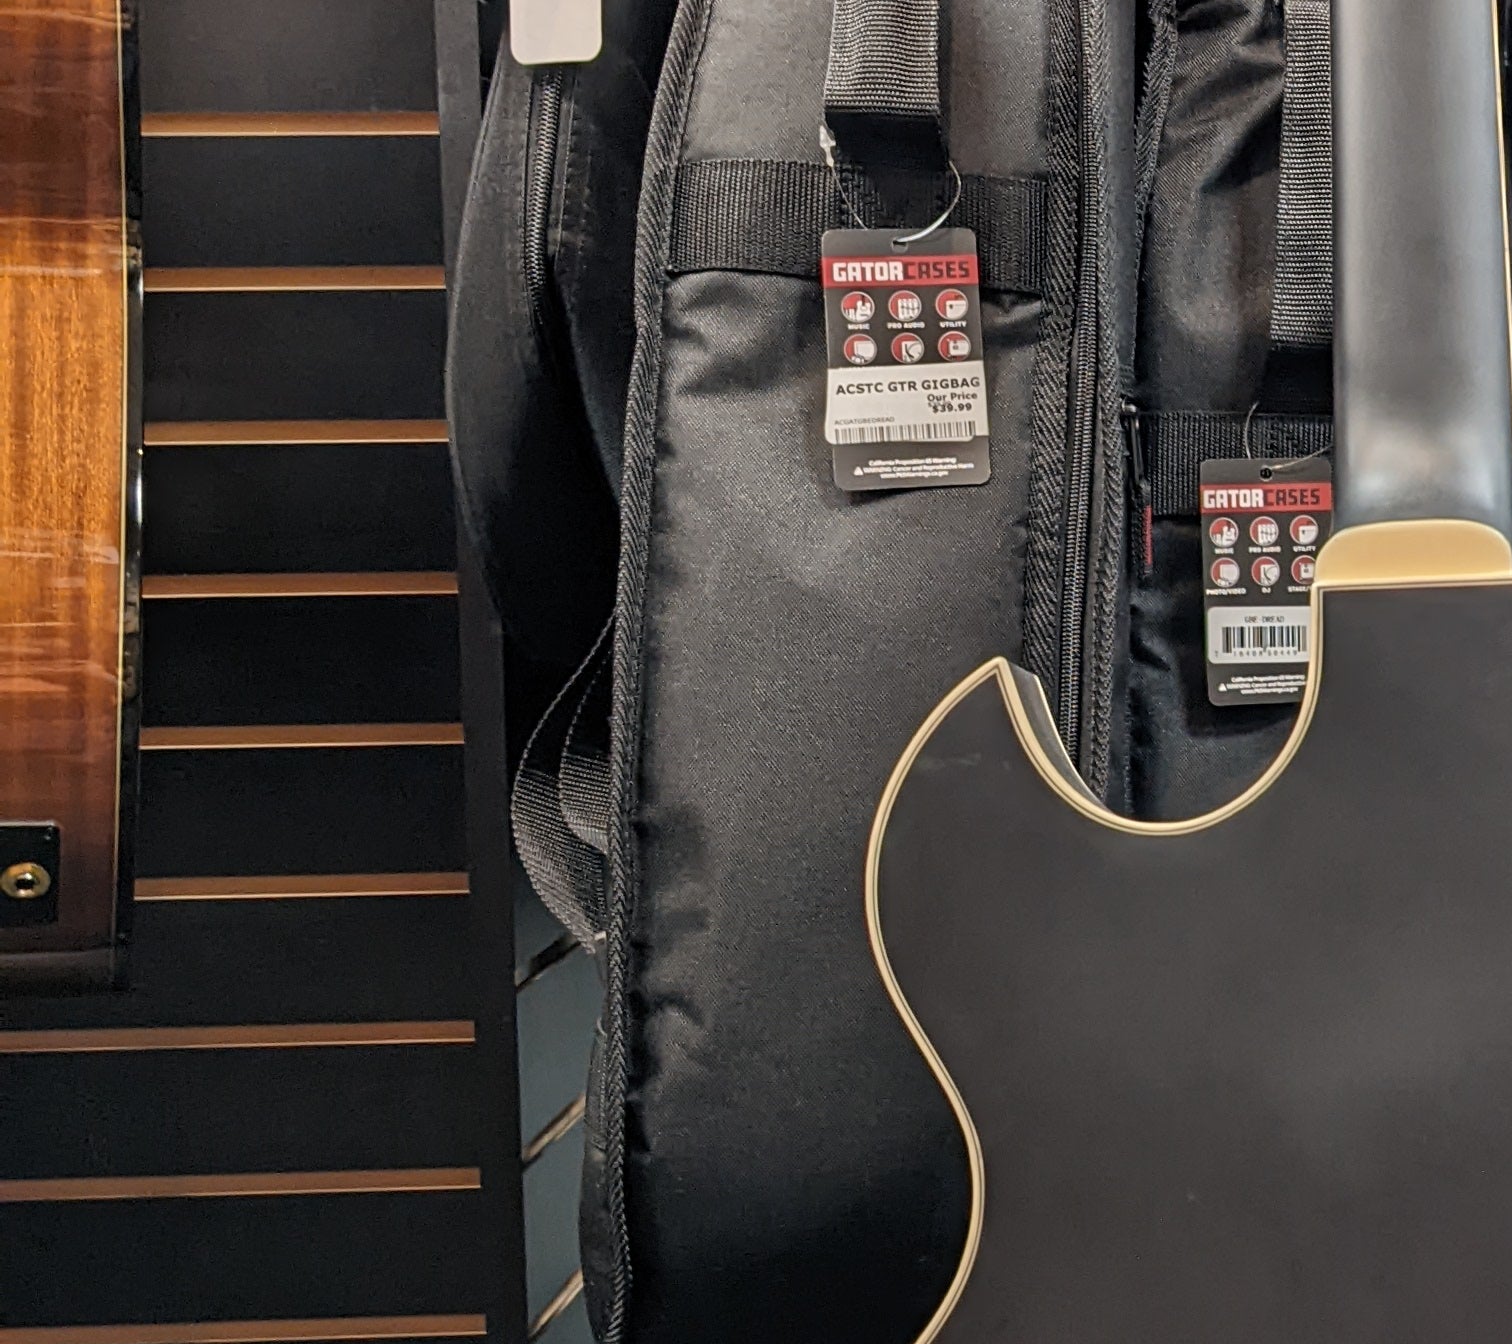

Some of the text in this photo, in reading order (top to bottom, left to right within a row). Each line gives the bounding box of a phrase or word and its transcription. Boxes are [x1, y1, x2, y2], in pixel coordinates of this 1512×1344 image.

[835, 376, 981, 395] ACSTC GTR GIGBAG
[926, 391, 978, 402] Our Price
[932, 402, 973, 413] $39.99
